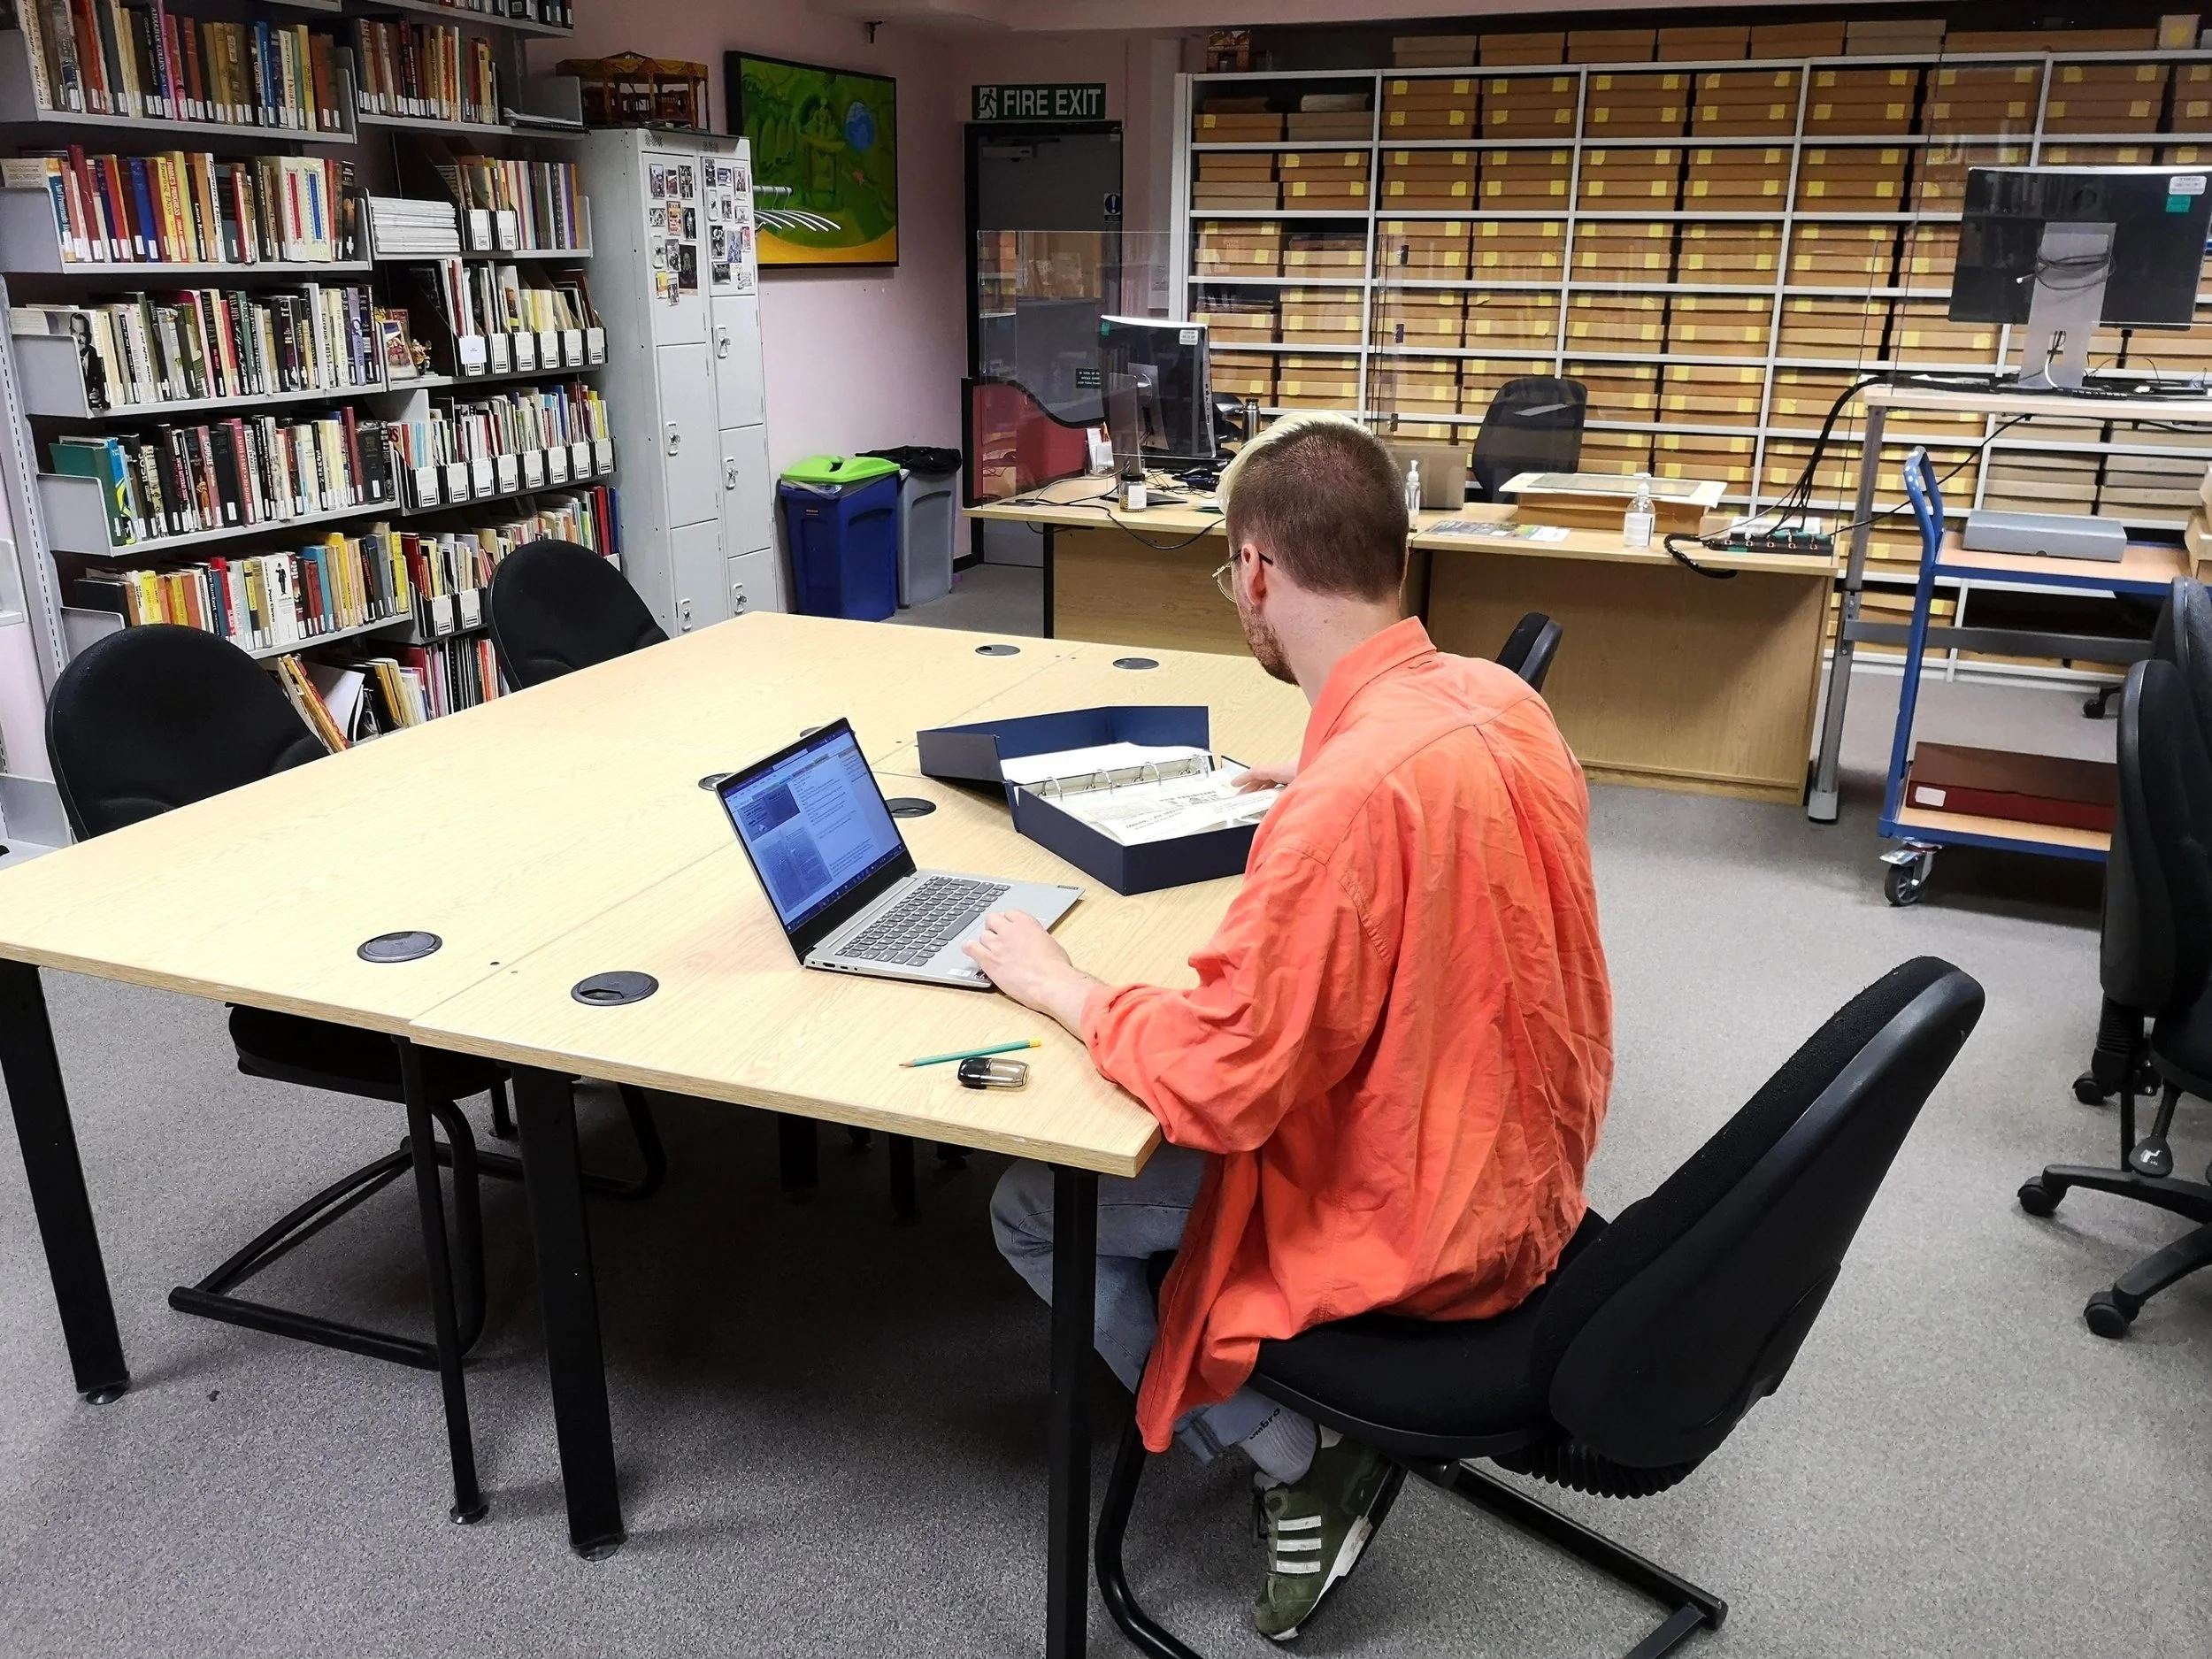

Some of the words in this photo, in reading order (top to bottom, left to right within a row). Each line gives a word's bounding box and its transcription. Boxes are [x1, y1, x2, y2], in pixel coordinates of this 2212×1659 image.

[156, 45, 165, 71] COLLINS
[1003, 89, 1048, 116] FIRE
[1056, 88, 1102, 115] EXIT
[171, 187, 180, 216] PROGRESS
[203, 296, 215, 321] JAMES
[206, 324, 218, 343] DEAN
[138, 453, 148, 482] JOSH
[204, 442, 213, 466] GOOGIE
[1248, 1408, 1280, 1440] umbro
